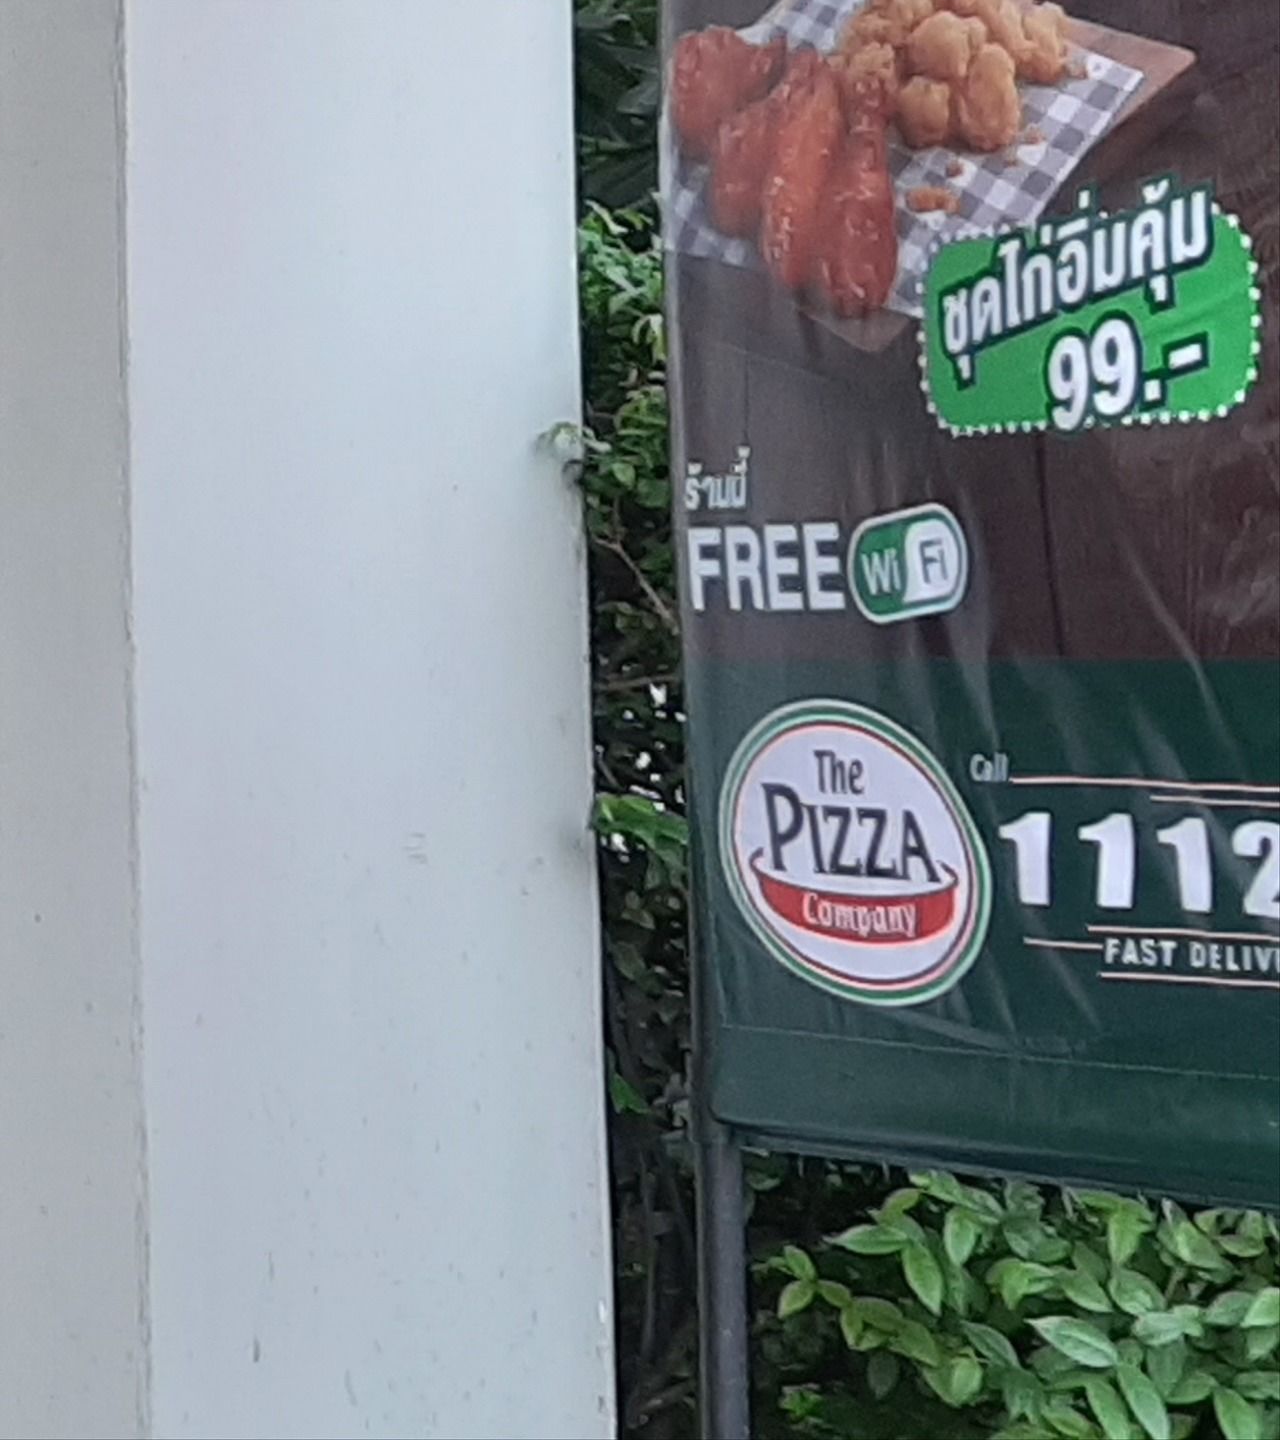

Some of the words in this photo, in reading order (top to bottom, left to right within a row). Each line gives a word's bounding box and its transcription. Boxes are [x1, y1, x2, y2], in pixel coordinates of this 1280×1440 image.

[942, 180, 1207, 384] ชุดไก่อิ่มคุ้ม
[1050, 318, 1203, 430] 99.-
[688, 521, 845, 612] FREE
[813, 749, 864, 796] The
[969, 752, 1010, 783] Call
[761, 782, 942, 883] PIZZA
[998, 810, 1280, 920] 1112
[802, 891, 917, 939] Company
[1103, 937, 1178, 969] FAST
